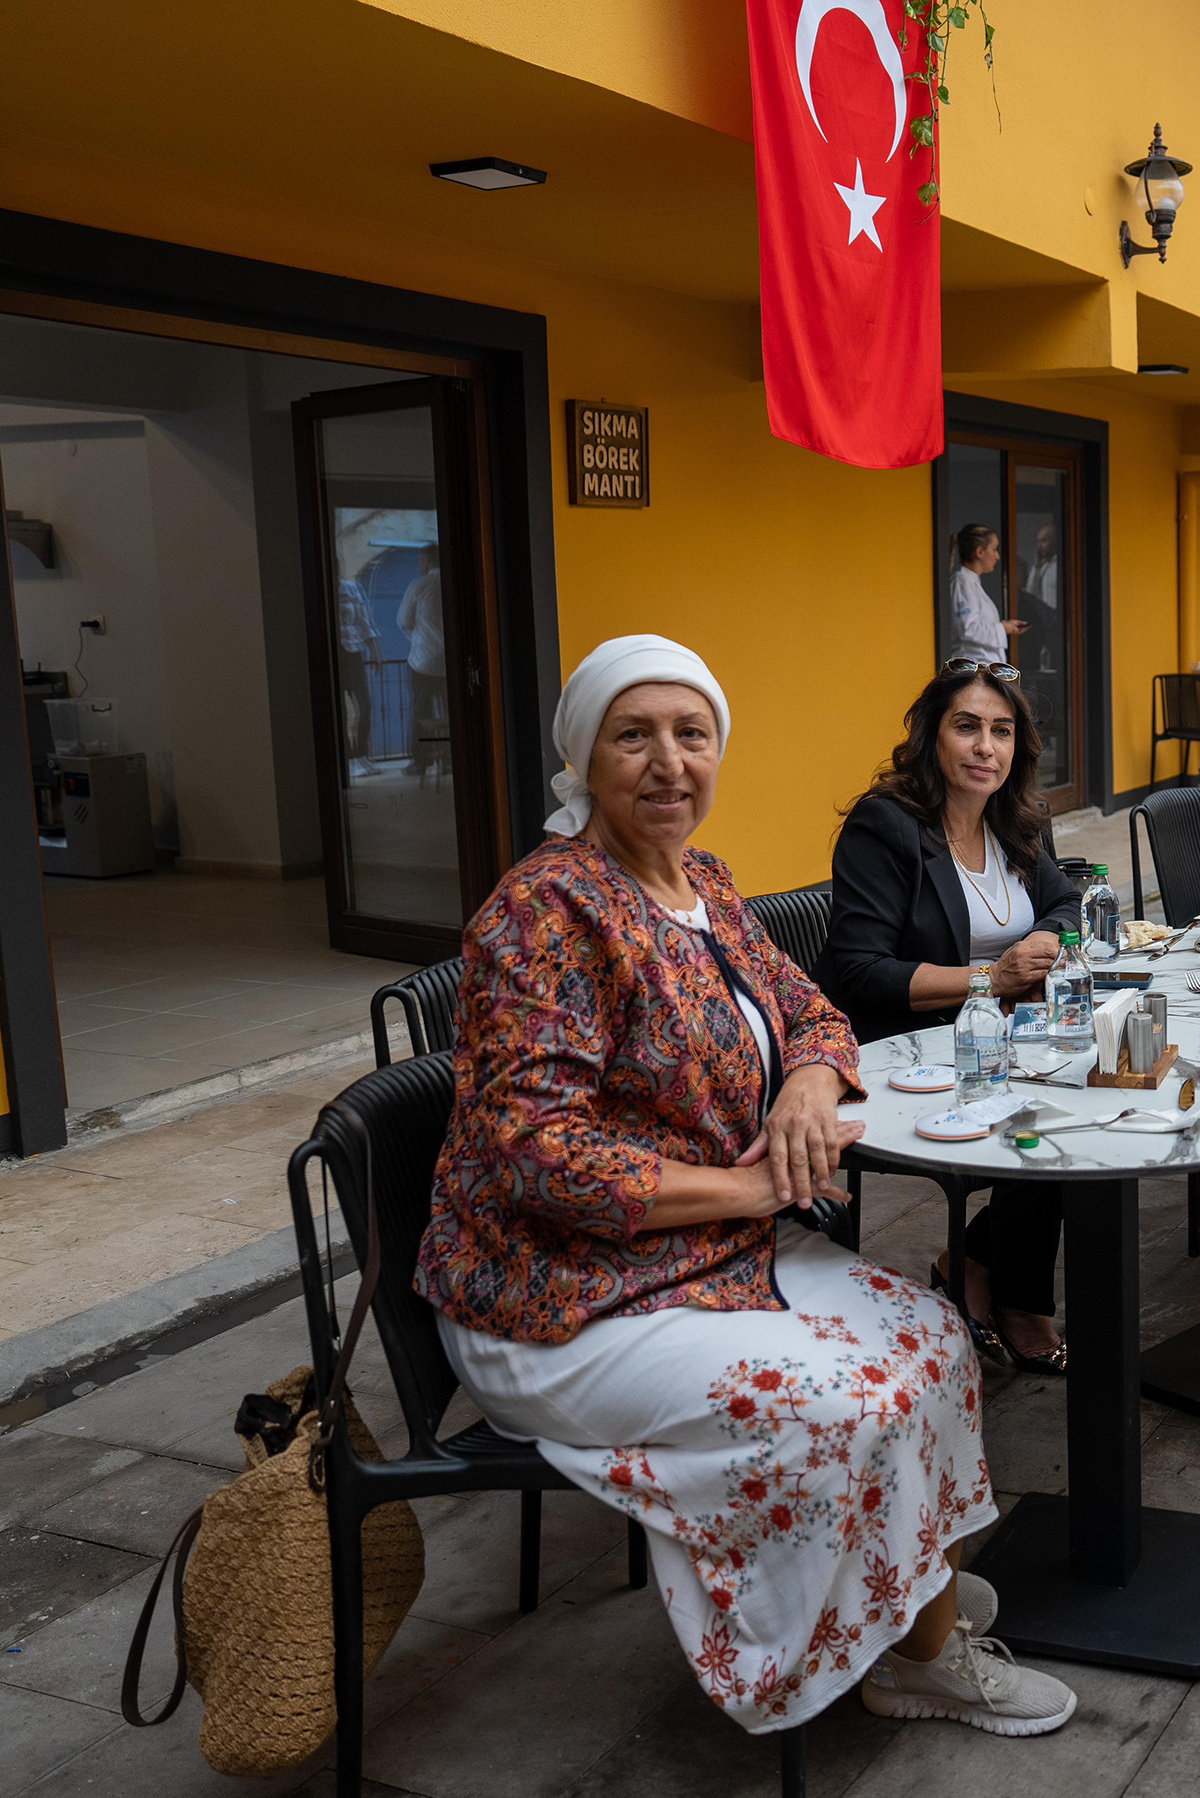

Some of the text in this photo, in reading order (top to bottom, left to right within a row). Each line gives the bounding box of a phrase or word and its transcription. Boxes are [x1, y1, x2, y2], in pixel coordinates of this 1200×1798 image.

[583, 411, 639, 439] SIKMA
[583, 437, 640, 471] BÖREK
[584, 472, 640, 498] MANTI
